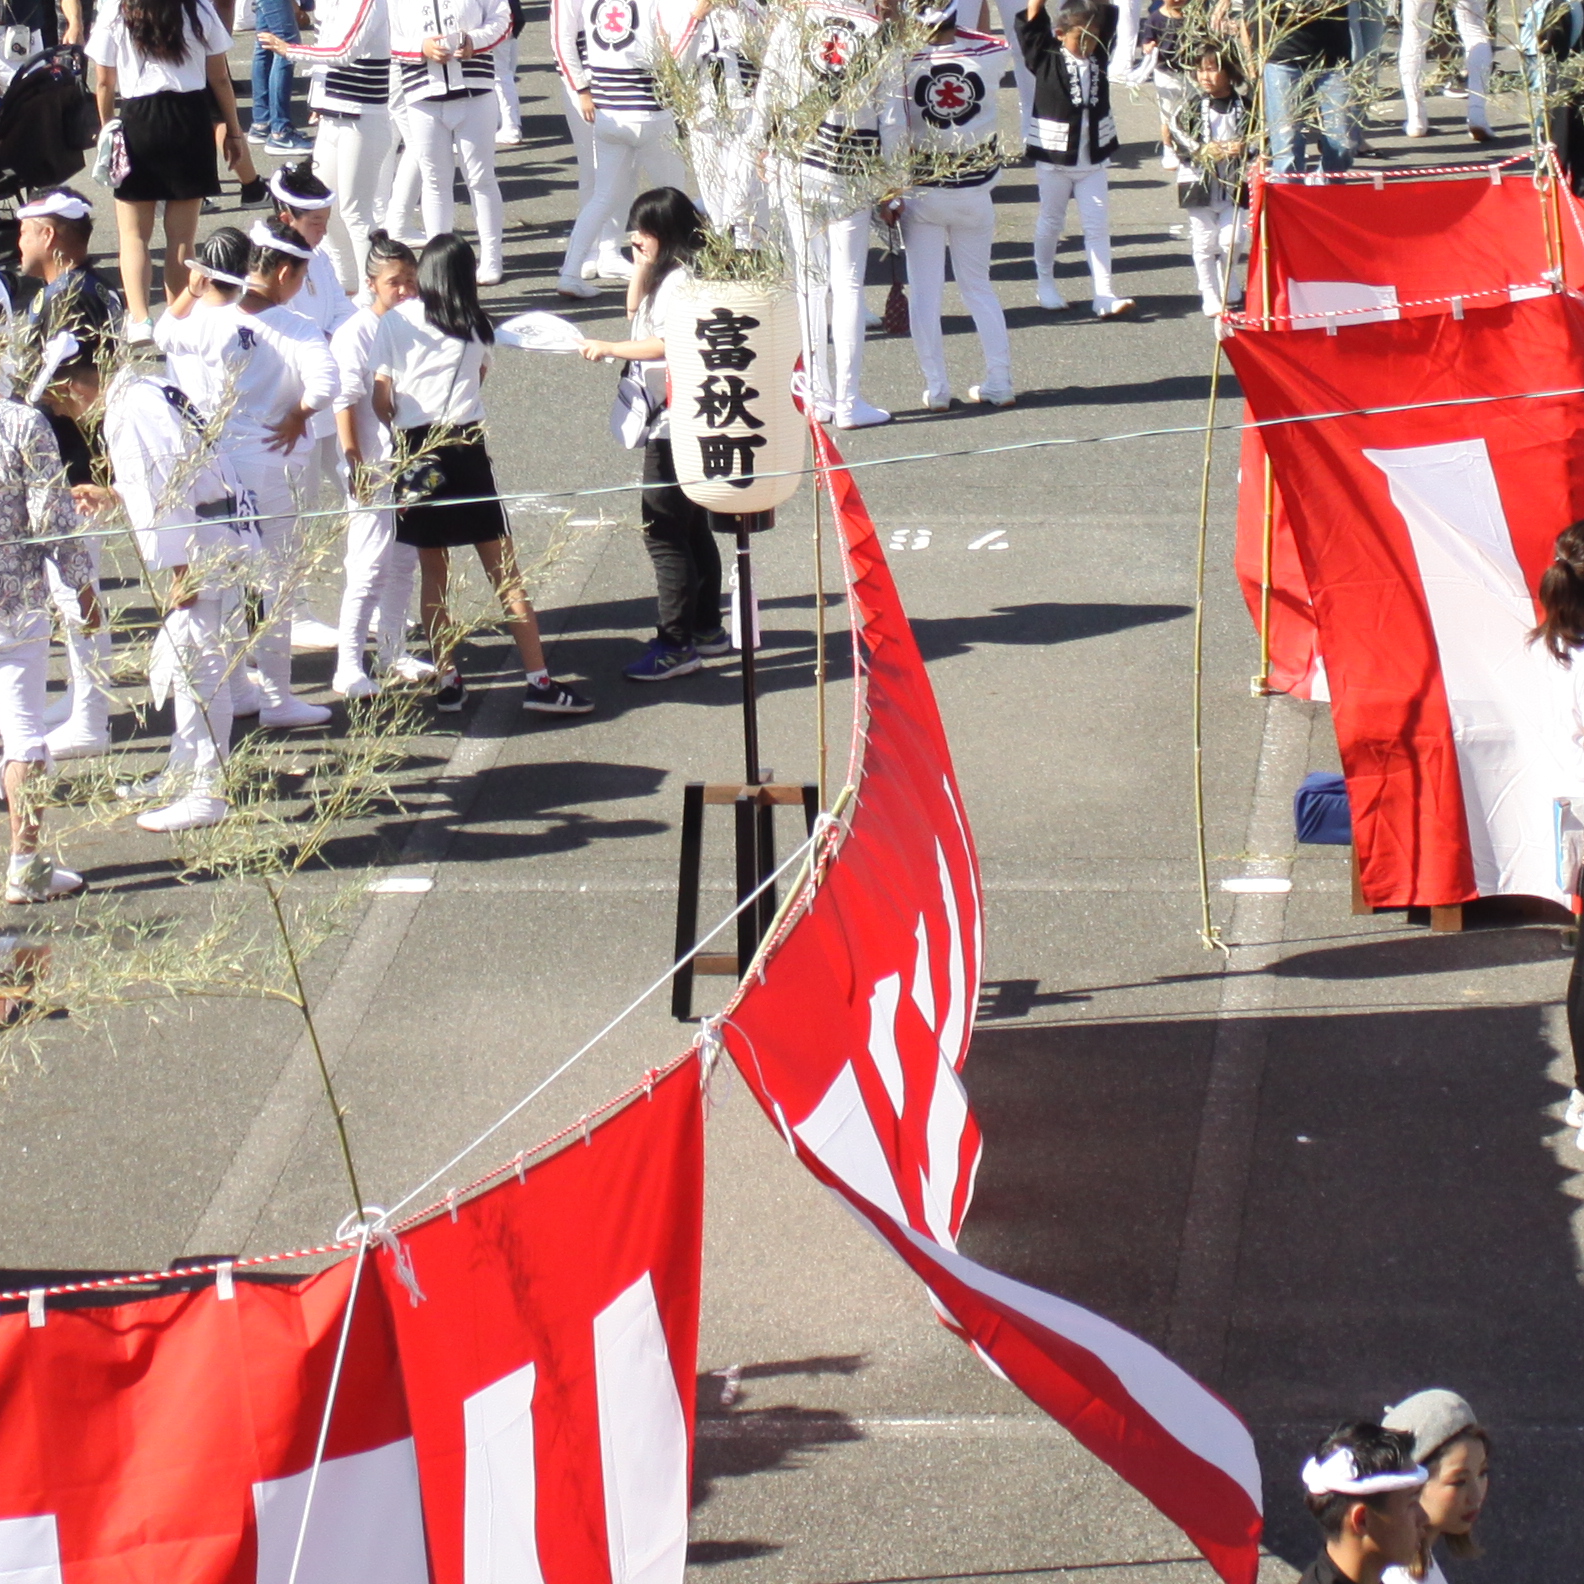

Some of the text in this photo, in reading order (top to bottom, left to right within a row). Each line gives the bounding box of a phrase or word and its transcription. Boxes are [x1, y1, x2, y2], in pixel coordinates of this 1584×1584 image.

[934, 80, 967, 109] 太
[693, 307, 767, 490] 富秋町
